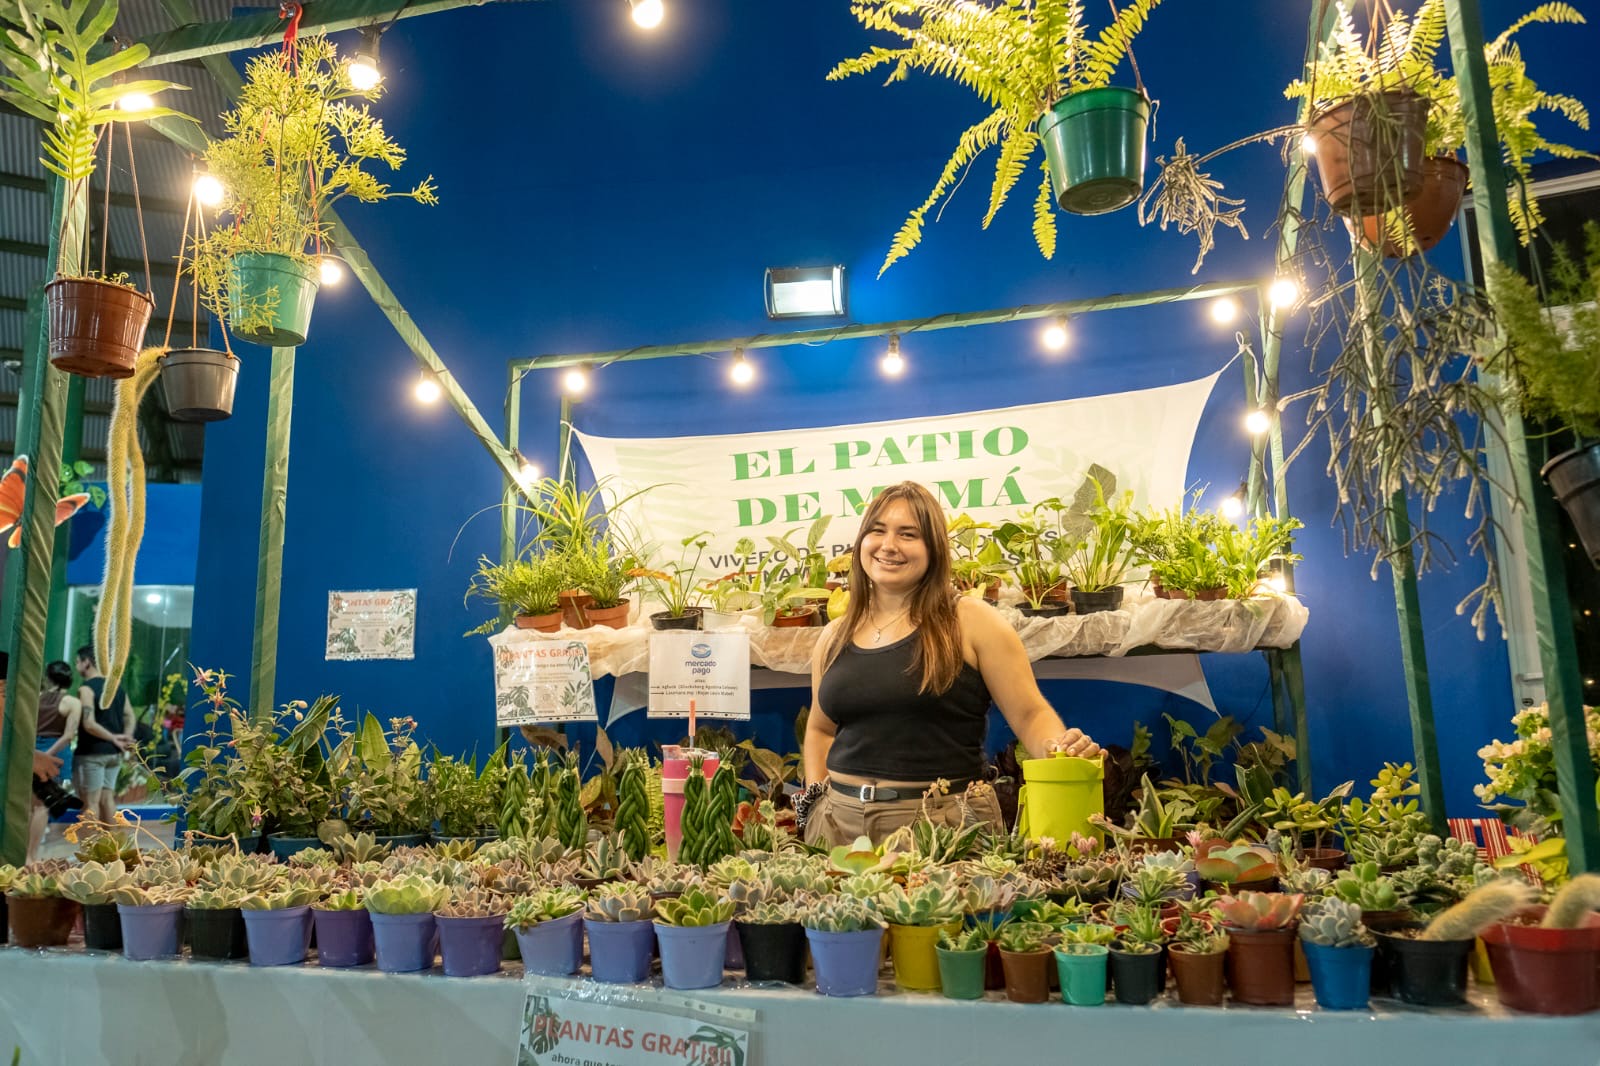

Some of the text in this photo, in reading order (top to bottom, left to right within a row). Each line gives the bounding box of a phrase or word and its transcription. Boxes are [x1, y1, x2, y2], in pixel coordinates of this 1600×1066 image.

[730, 426, 1029, 480] EL PATIO
[731, 466, 1033, 527] DE MMÁ
[709, 549, 789, 569] VIVERO
[692, 667, 711, 675] pago
[532, 1014, 635, 1049] PLANTAS
[551, 1053, 581, 1066] ahora
